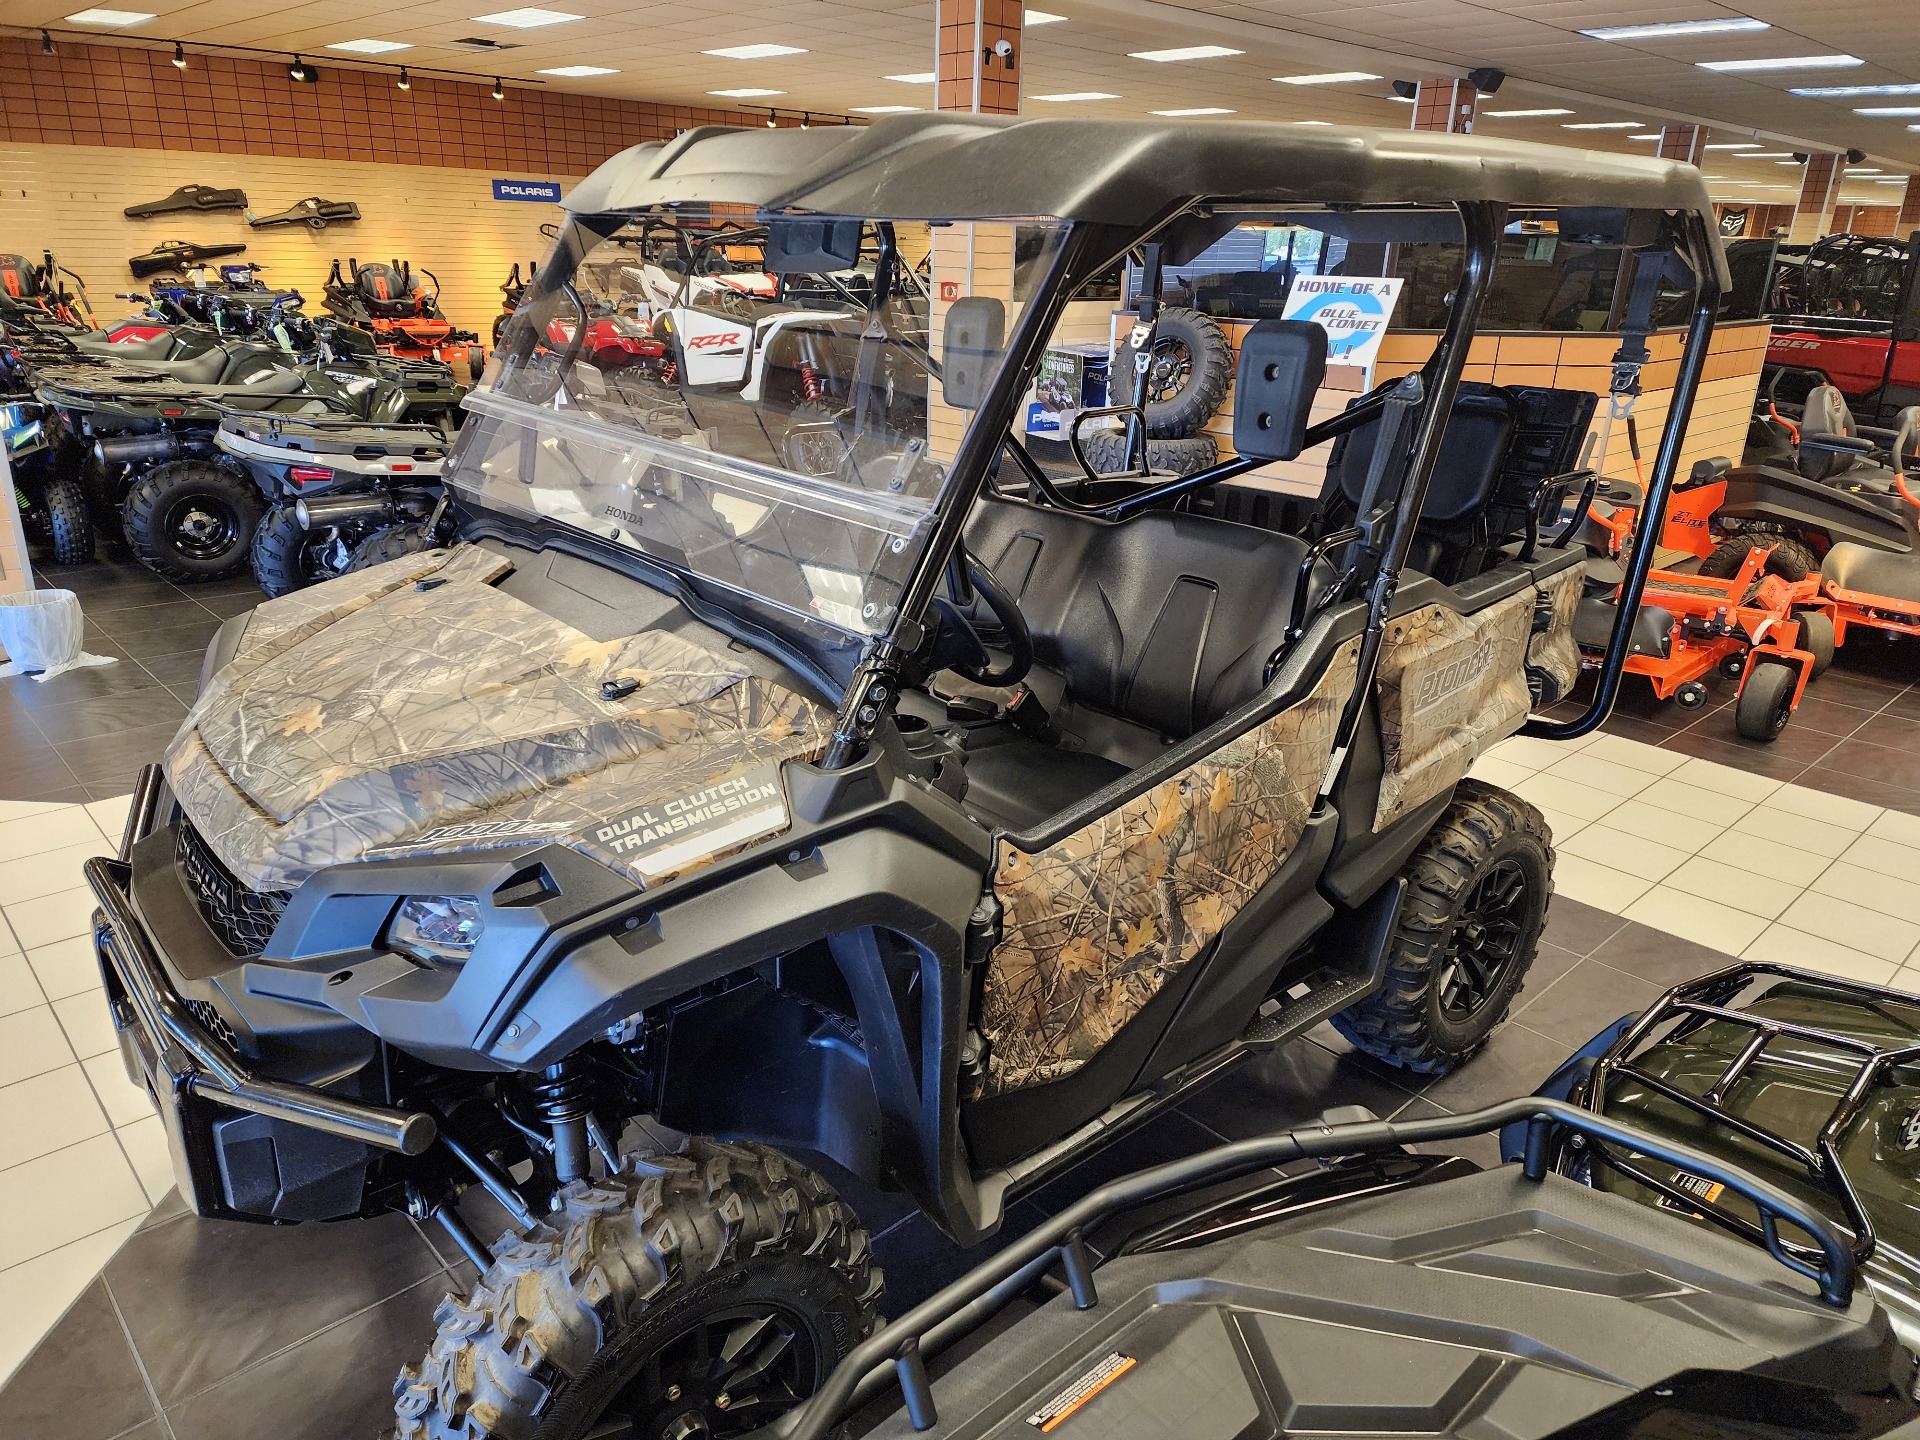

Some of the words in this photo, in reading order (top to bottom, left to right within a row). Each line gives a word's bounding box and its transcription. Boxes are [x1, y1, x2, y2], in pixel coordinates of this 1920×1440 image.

[500, 185, 554, 197] POLARIS
[1297, 281, 1346, 293] HOME
[1351, 283, 1374, 295] OF
[1377, 284, 1391, 296] A
[1319, 308, 1359, 319] BLUE
[1327, 318, 1382, 330] COMET
[687, 332, 741, 351] RZR
[604, 505, 643, 526] HONDA
[1671, 516, 1707, 528] ELITE
[1414, 637, 1493, 709] PIONEER
[1420, 703, 1460, 732] HONDA
[596, 812, 659, 842] DUAL
[664, 776, 749, 817] CLUTCH
[609, 783, 777, 854] TRANSMISSION
